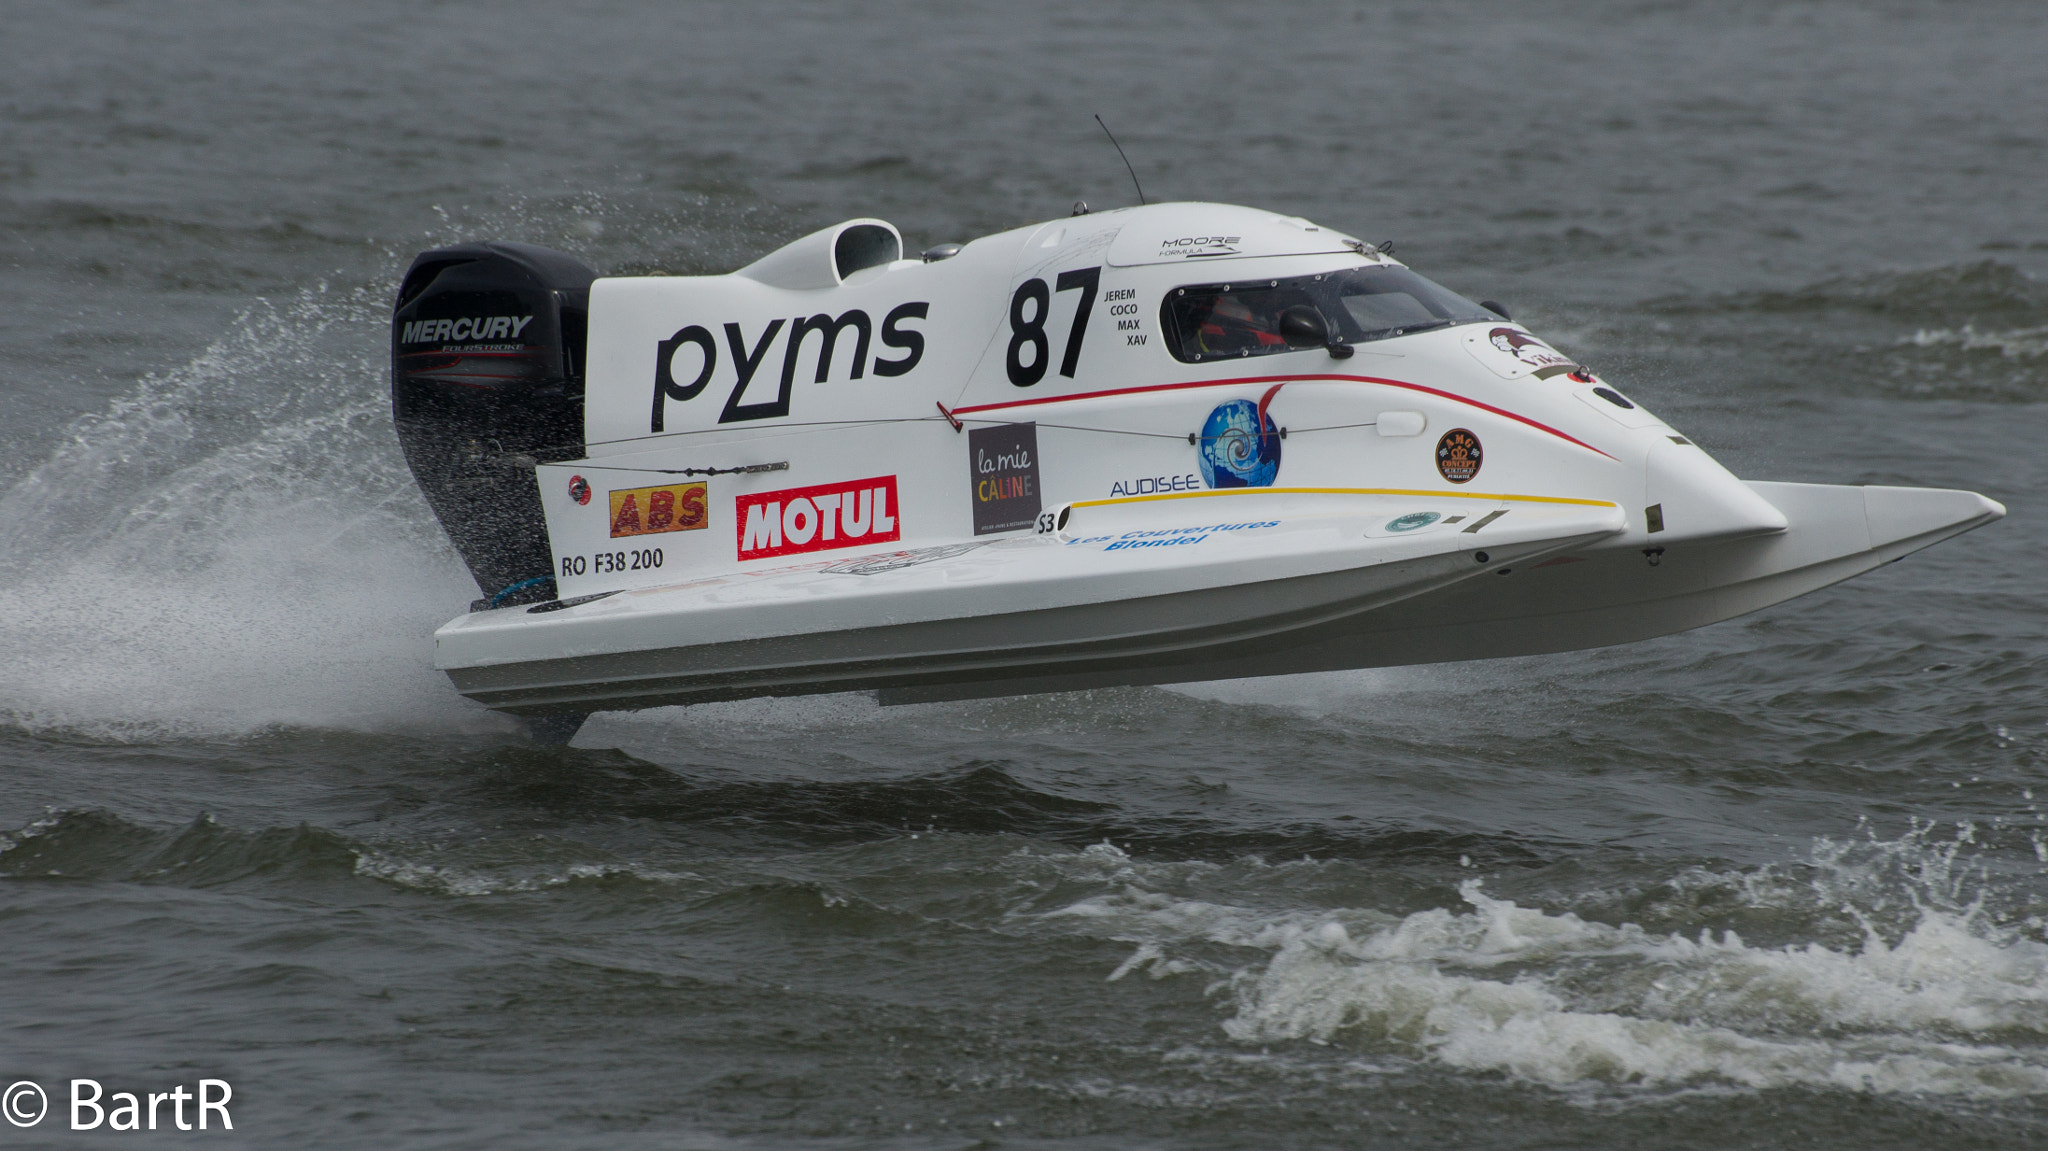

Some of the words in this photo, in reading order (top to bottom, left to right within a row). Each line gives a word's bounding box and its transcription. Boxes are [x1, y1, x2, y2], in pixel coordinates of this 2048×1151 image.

[1159, 247, 1203, 257] FORMULA
[1162, 236, 1241, 248] MOORE
[1104, 288, 1136, 303] JEREM
[1110, 303, 1138, 316] COCO
[401, 315, 533, 344] MERCURY
[1006, 265, 1102, 388] 87
[1117, 319, 1140, 331] MAX
[442, 343, 525, 353] FOURSTROKE
[1127, 334, 1148, 347] XAV
[651, 301, 930, 433] pyms
[978, 448, 996, 474] la
[997, 443, 1032, 471] mie
[1441, 460, 1477, 468] CONCEPT
[978, 474, 1033, 502] CÂLINE
[1110, 474, 1200, 498] AUDISEE
[611, 487, 706, 534] ABS
[741, 487, 895, 552] MOTUL
[1038, 513, 1055, 534] S3
[1064, 534, 1114, 546] Les
[1120, 519, 1282, 540] Couvertures
[1104, 533, 1211, 552] Blondel
[562, 555, 587, 576] RO
[594, 552, 627, 574] F38
[630, 548, 664, 571] 200
